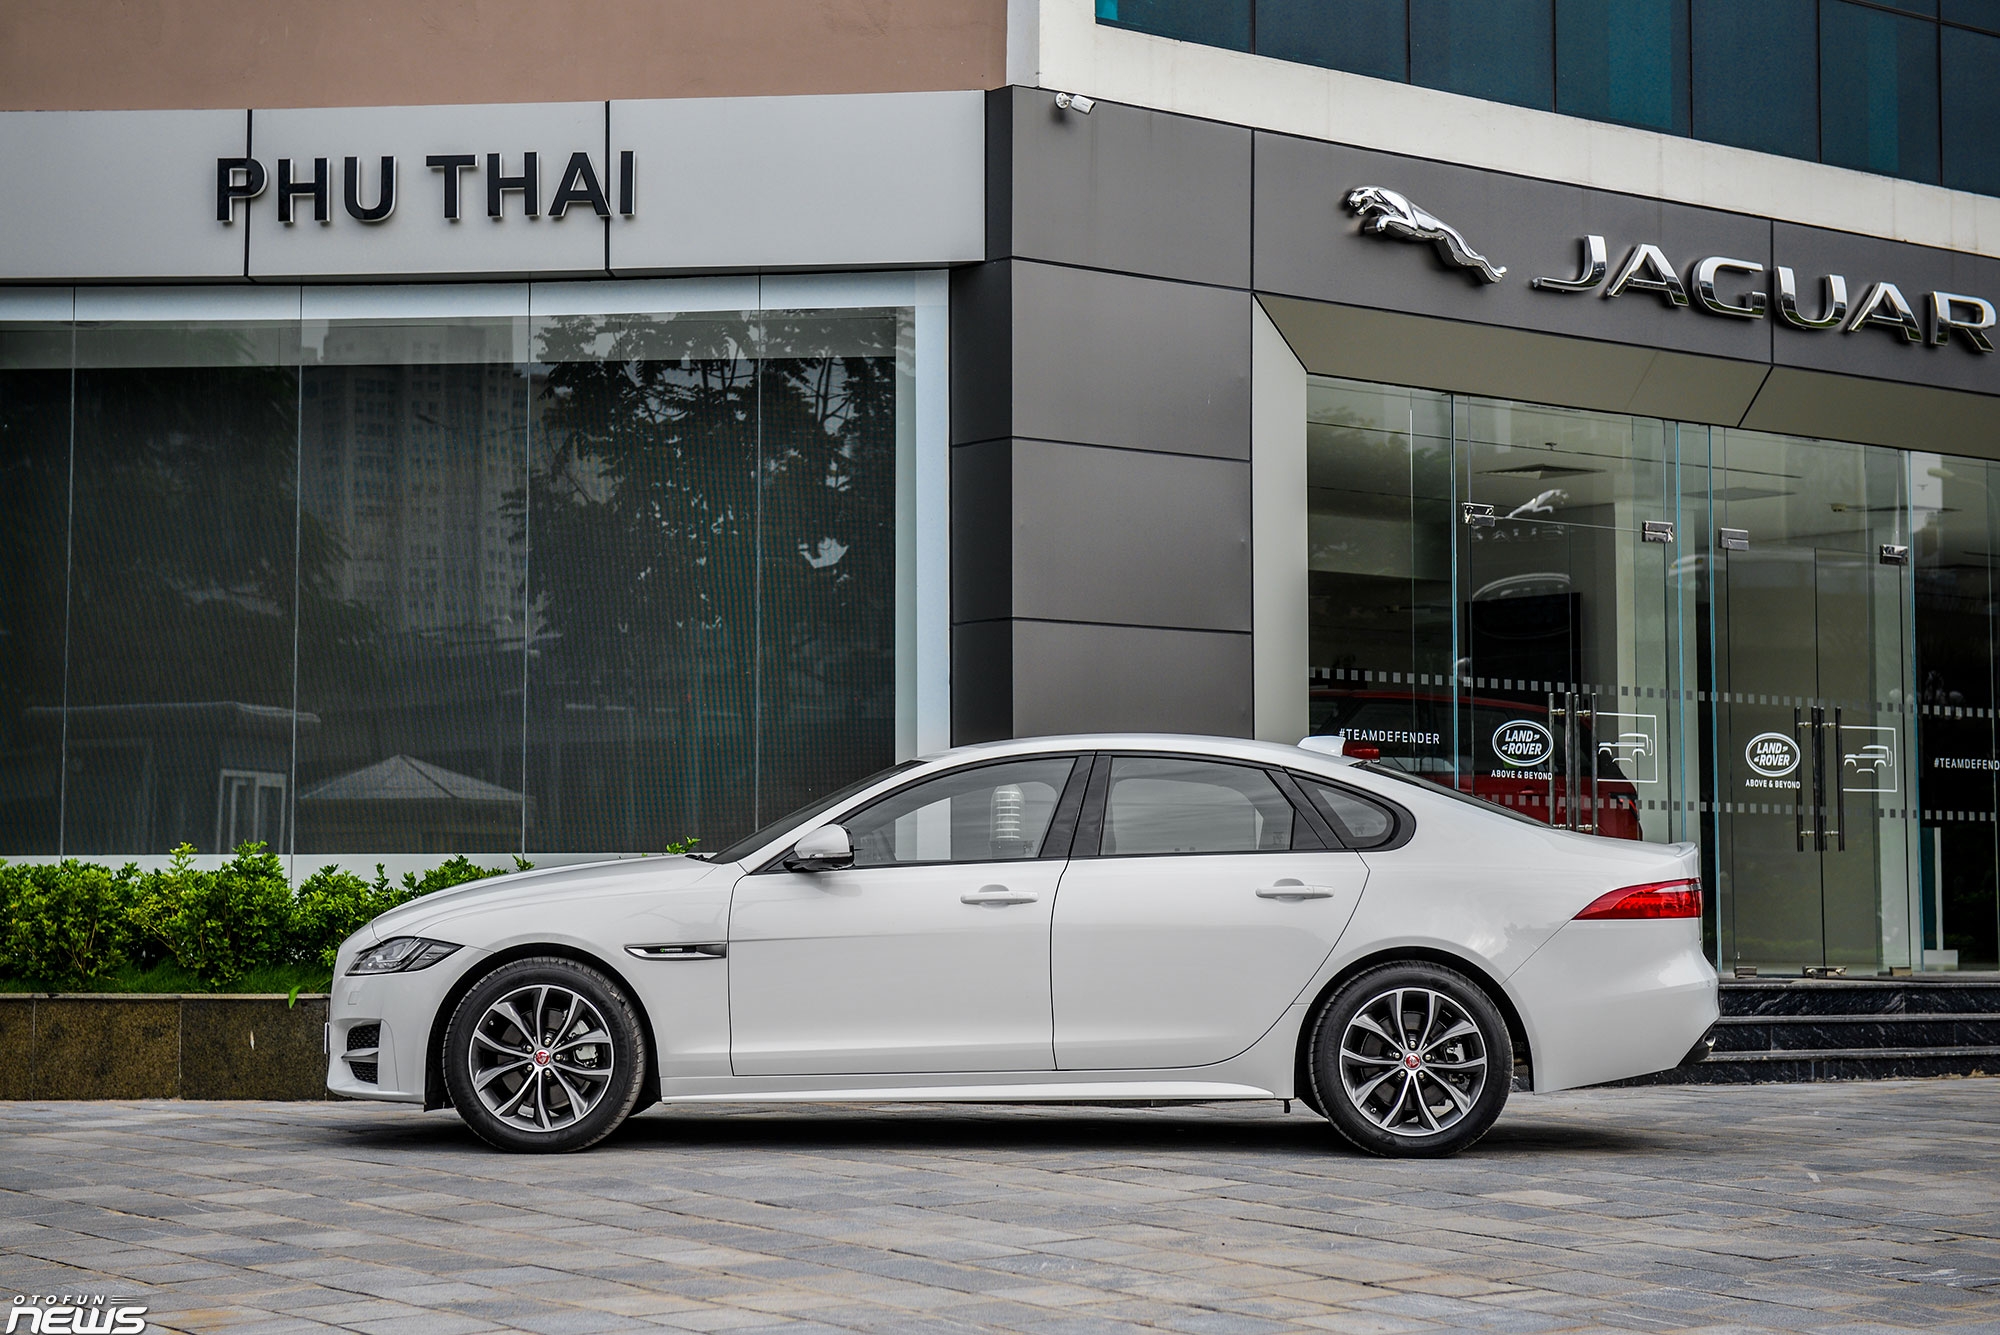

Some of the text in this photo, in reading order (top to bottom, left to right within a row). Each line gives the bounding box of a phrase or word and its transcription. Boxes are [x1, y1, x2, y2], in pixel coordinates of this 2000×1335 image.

[216, 150, 637, 223] PHU THAI
[1532, 234, 1998, 353] JAGUAR
[1339, 728, 1440, 745] #TEAMDEFENDER
[1505, 729, 1534, 742] LAND
[1507, 742, 1543, 755] ROVER
[1756, 742, 1783, 754] LAND
[1759, 754, 1791, 766] ROVER
[1491, 769, 1553, 781] ABOVE & BEYOND
[1745, 779, 1801, 789] ABOVE & BEYOND
